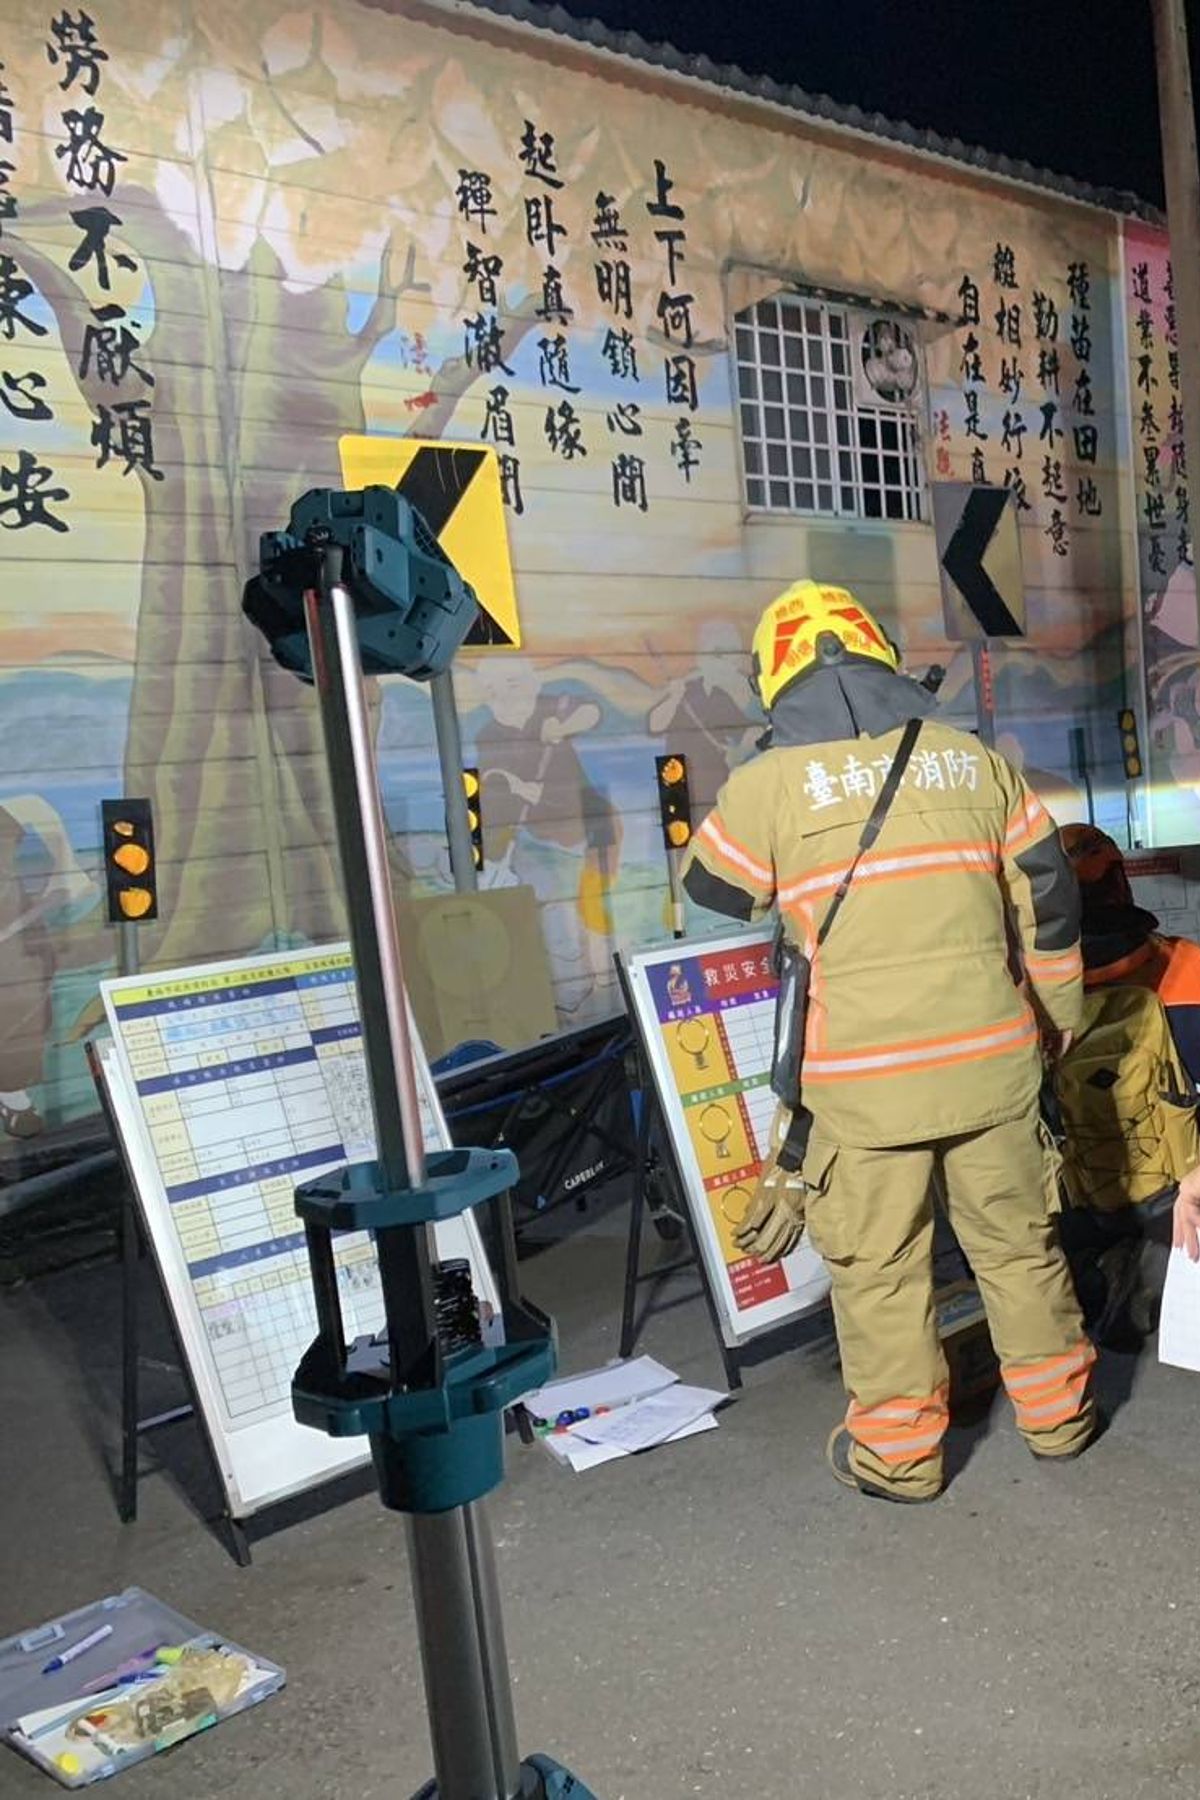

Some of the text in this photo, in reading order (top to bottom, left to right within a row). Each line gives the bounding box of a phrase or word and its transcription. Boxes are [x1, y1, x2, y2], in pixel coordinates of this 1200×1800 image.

[518, 119, 588, 460] 起臥真隨緣
[589, 191, 648, 512] 無明鎖心間
[1032, 287, 1068, 557] 勤耕不起意
[1067, 262, 1101, 517] 種苗在田地
